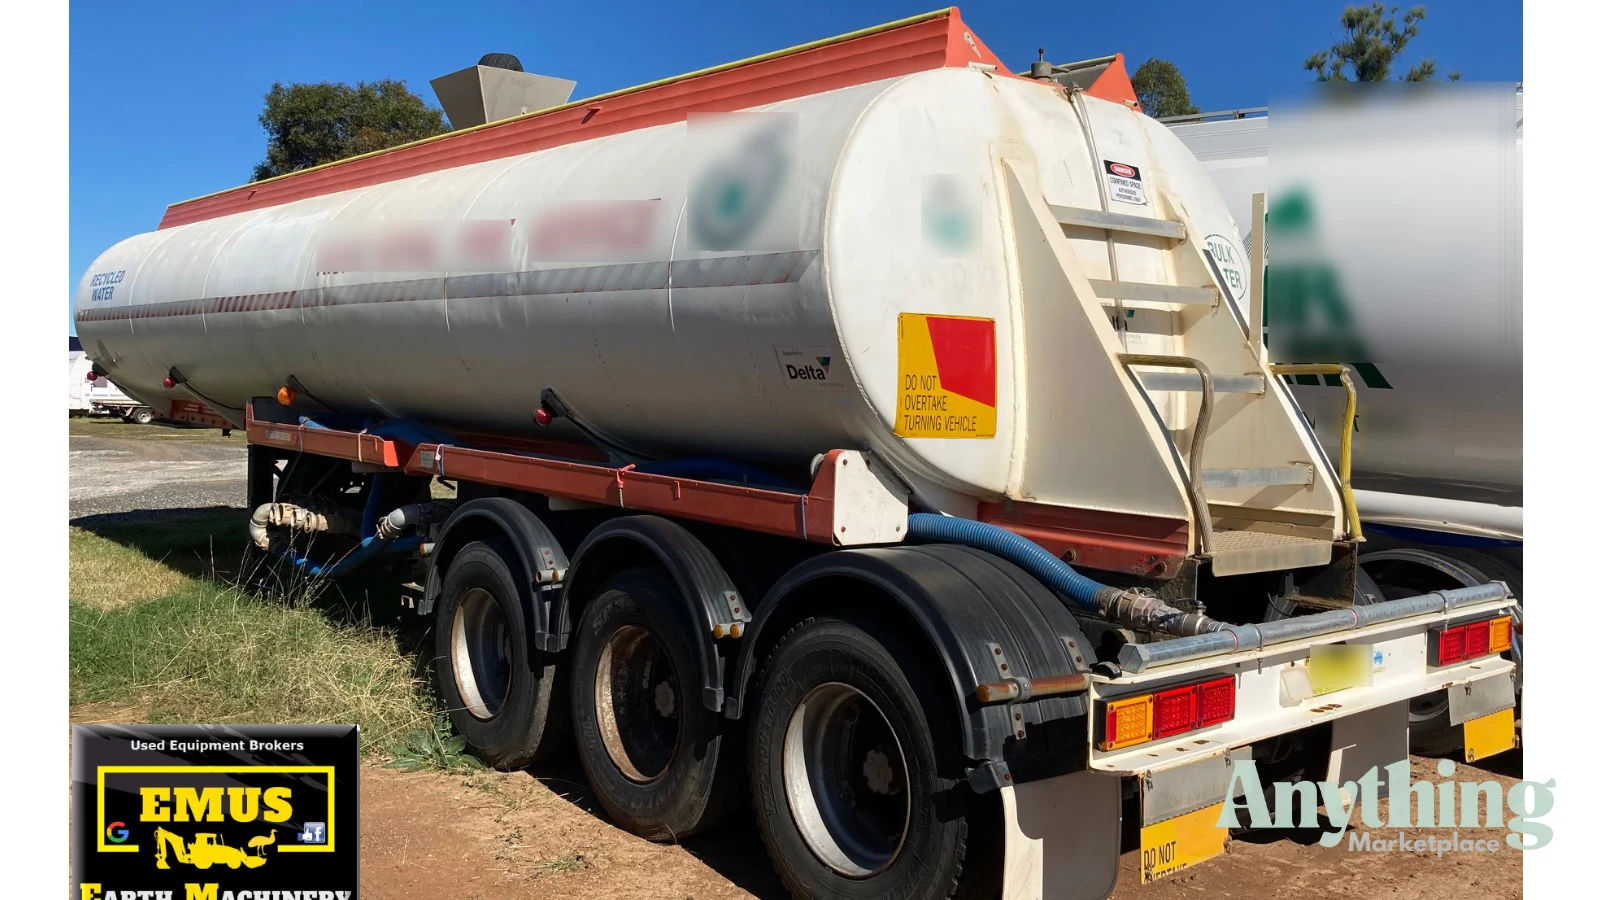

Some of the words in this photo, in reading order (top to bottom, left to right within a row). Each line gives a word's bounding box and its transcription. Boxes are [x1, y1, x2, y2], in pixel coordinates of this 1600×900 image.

[90, 270, 126, 287] RECYCLED
[1223, 267, 1243, 290] TER
[92, 286, 115, 301] WATER
[785, 364, 826, 381] Delta
[905, 374, 917, 391] DO
[920, 375, 937, 391] NOT
[904, 394, 948, 411] OVERTAKE
[903, 414, 942, 431] TURNING
[944, 416, 977, 432] VEHICLE
[1143, 847, 1157, 871] DO
[1158, 840, 1177, 866] NOT
